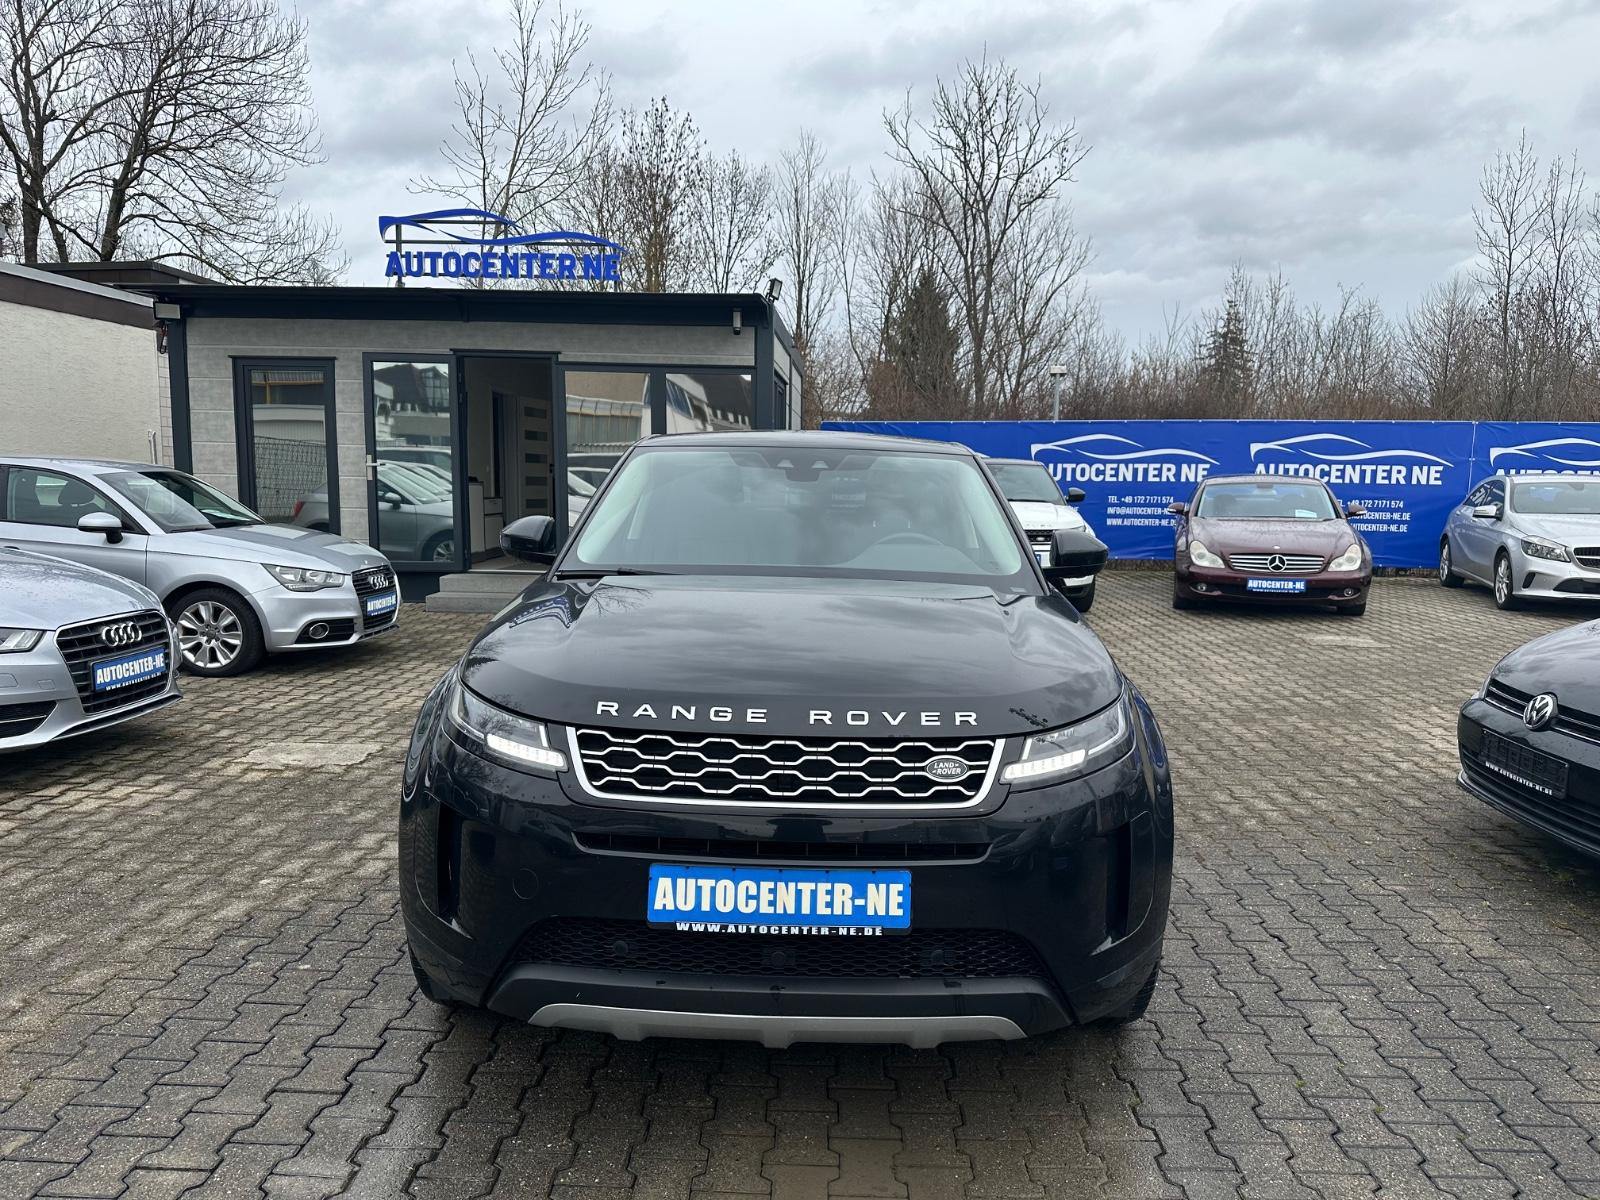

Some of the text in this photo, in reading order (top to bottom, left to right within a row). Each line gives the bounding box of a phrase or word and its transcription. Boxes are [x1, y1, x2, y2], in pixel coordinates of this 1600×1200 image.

[385, 251, 621, 281] AUTOCENTER NE
[1048, 463, 1176, 482] UTOCENTER
[1411, 465, 1444, 485] NE
[1121, 496, 1132, 504] +49
[1134, 496, 1145, 504] 172
[1146, 496, 1161, 504] 7171
[1162, 496, 1174, 504] 574
[1361, 499, 1373, 508] 172
[1374, 500, 1390, 508] 7171
[1391, 500, 1404, 509] 574
[1248, 579, 1305, 590] AUTOCENTER-NE
[96, 653, 165, 684] AUTOCENTER-NE
[596, 701, 978, 726] RANGE ROVER
[653, 877, 904, 916] AUTOCENTER-NE
[676, 922, 883, 936] WWW.AUTOCENTER-NE.DE
